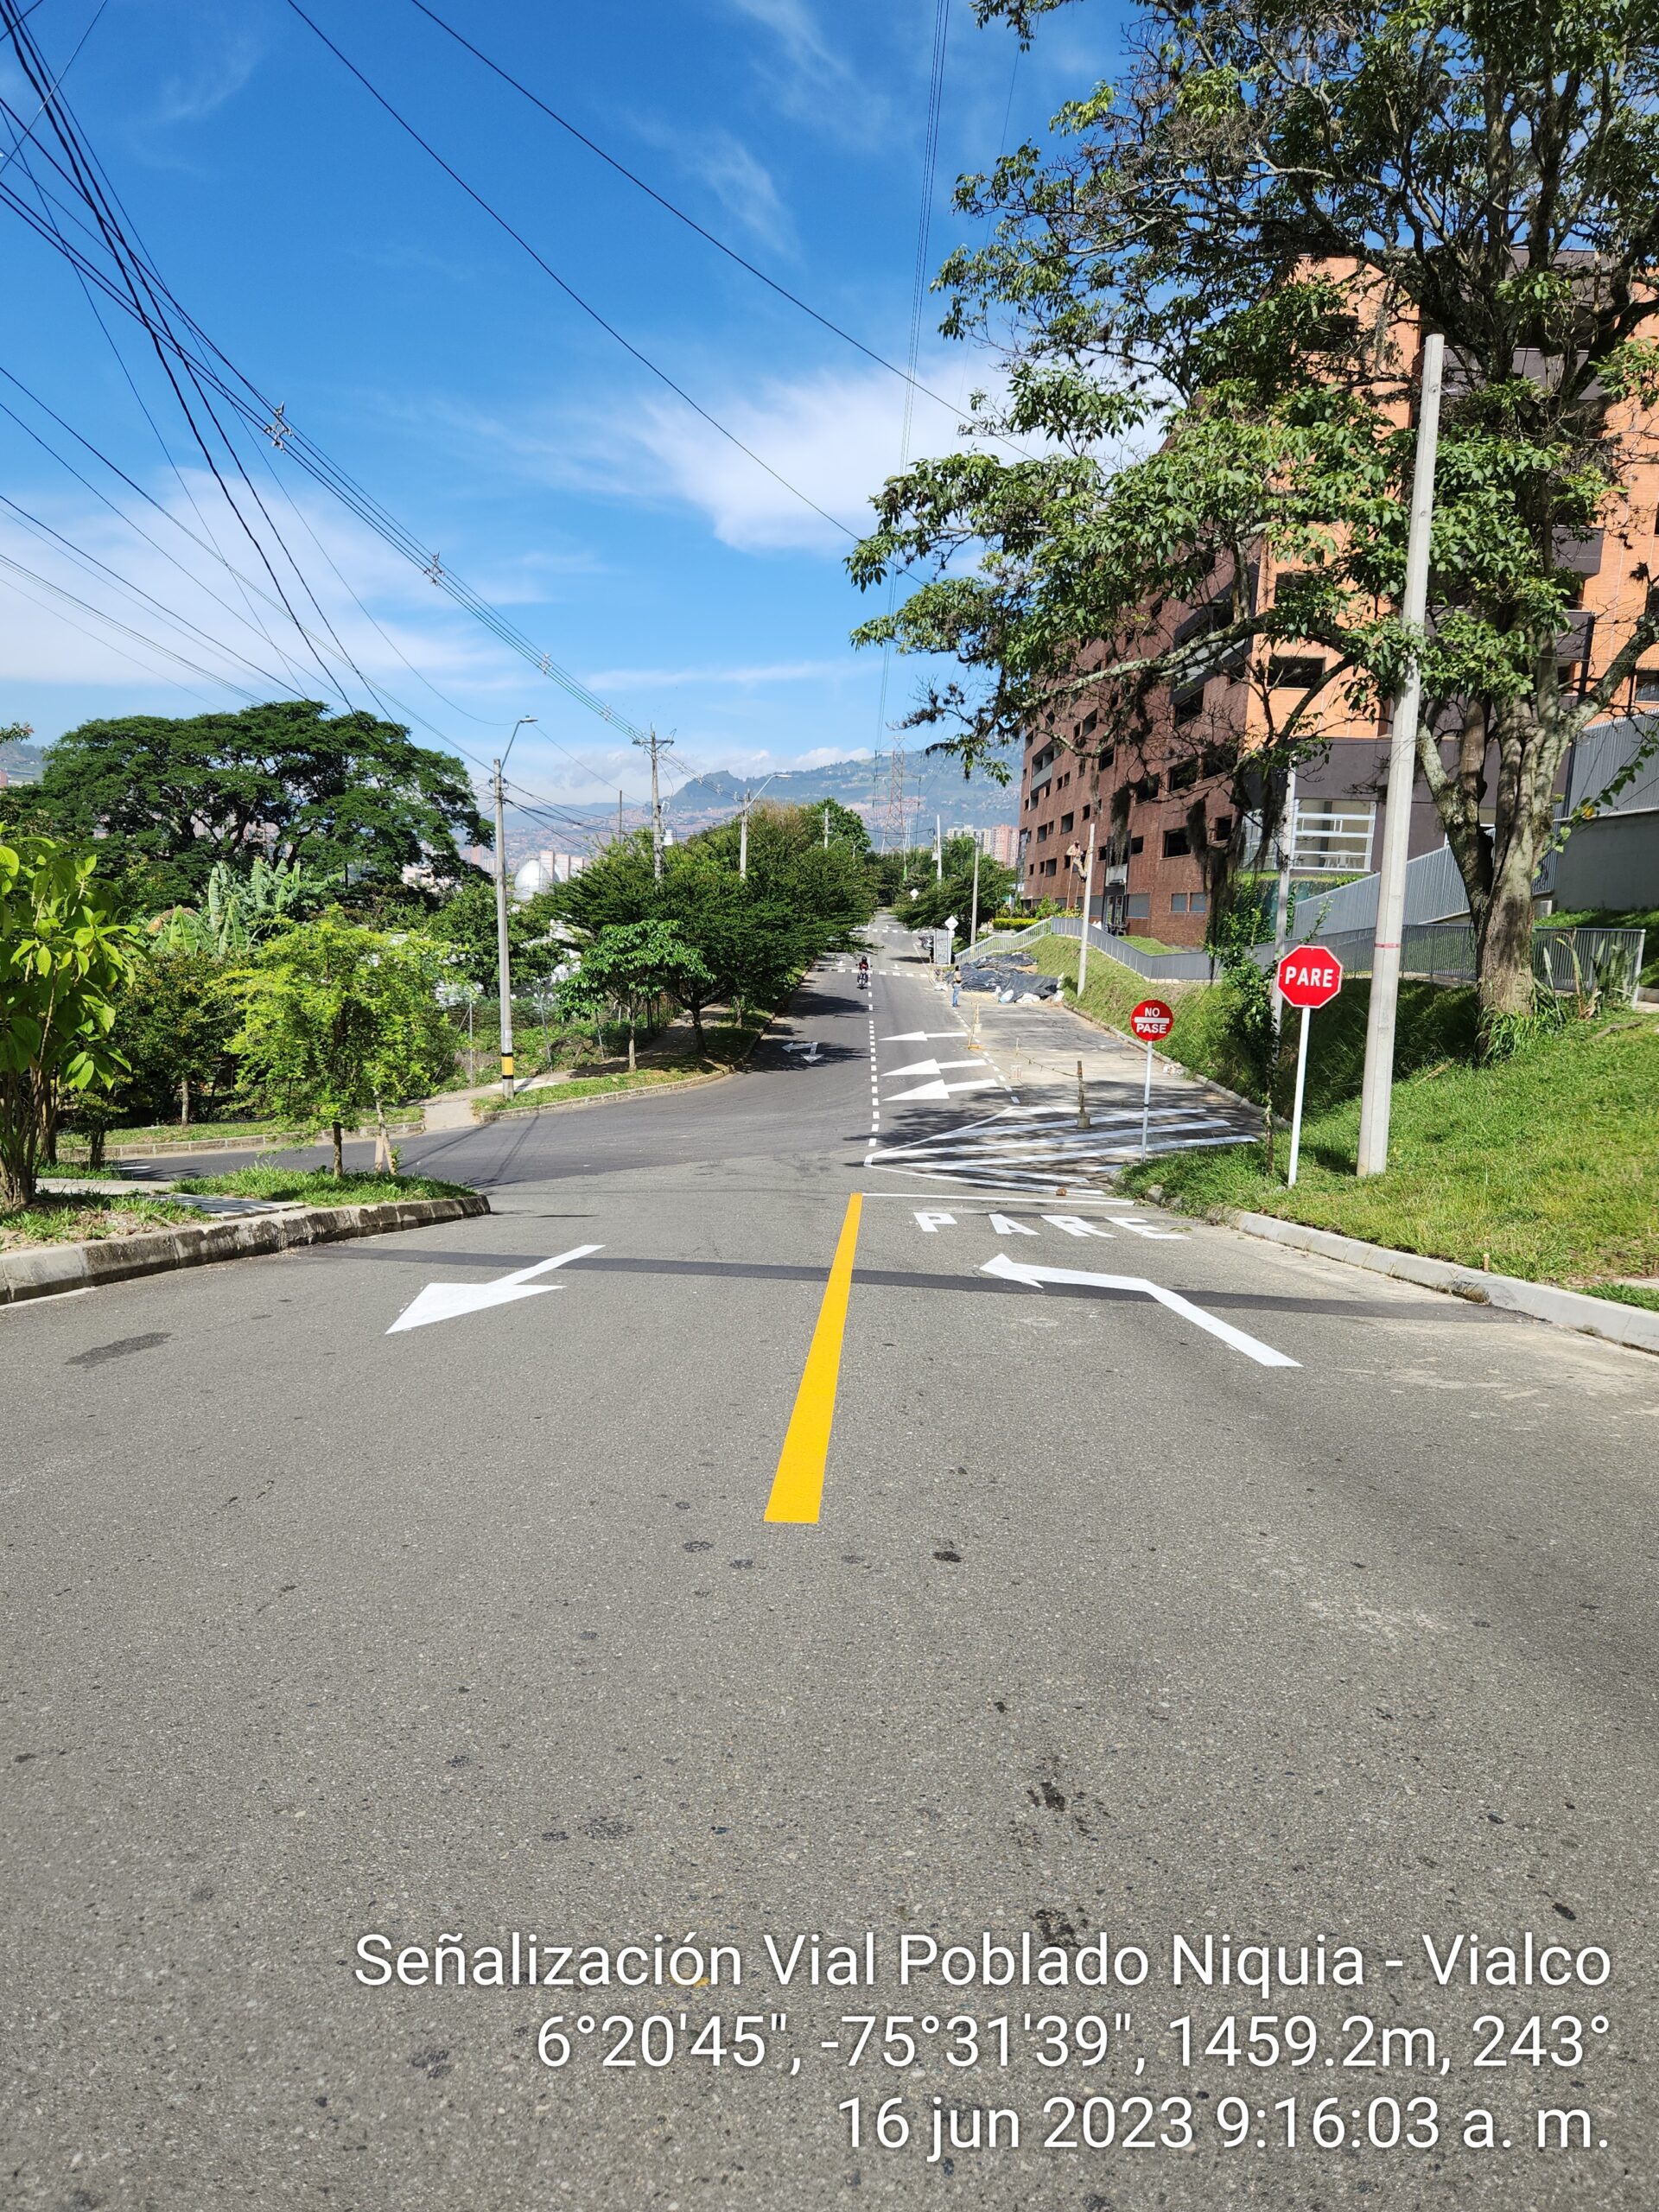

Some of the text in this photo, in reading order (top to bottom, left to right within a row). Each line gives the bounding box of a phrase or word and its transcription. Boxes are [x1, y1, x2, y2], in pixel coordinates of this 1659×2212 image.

[1284, 965, 1334, 988] PARE
[1144, 1007, 1160, 1018] NO
[1135, 1023, 1167, 1034] PASE
[912, 1211, 1192, 1241] PARE
